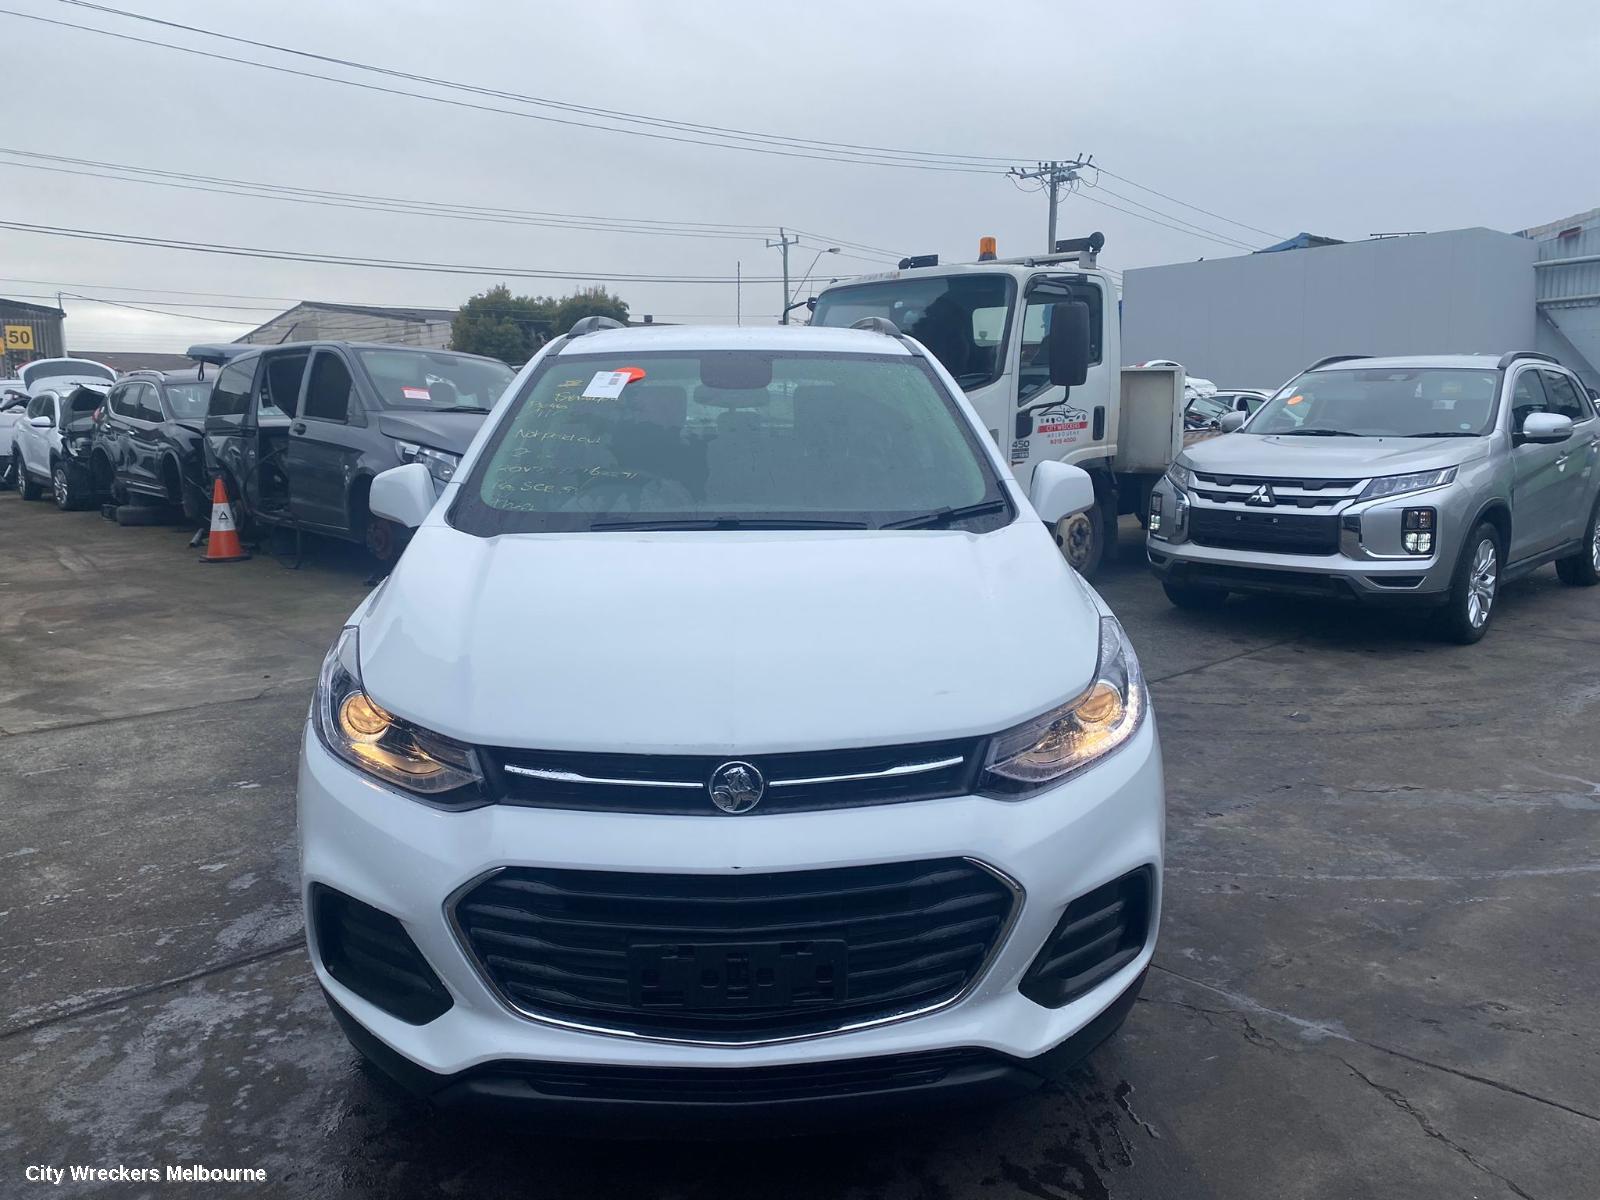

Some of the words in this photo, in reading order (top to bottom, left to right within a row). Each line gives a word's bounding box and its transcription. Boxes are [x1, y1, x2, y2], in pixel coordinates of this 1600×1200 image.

[9, 330, 30, 344] 50
[1046, 424, 1057, 432] CITY
[1057, 422, 1081, 431] WRECKERS
[1012, 440, 1030, 448] 450
